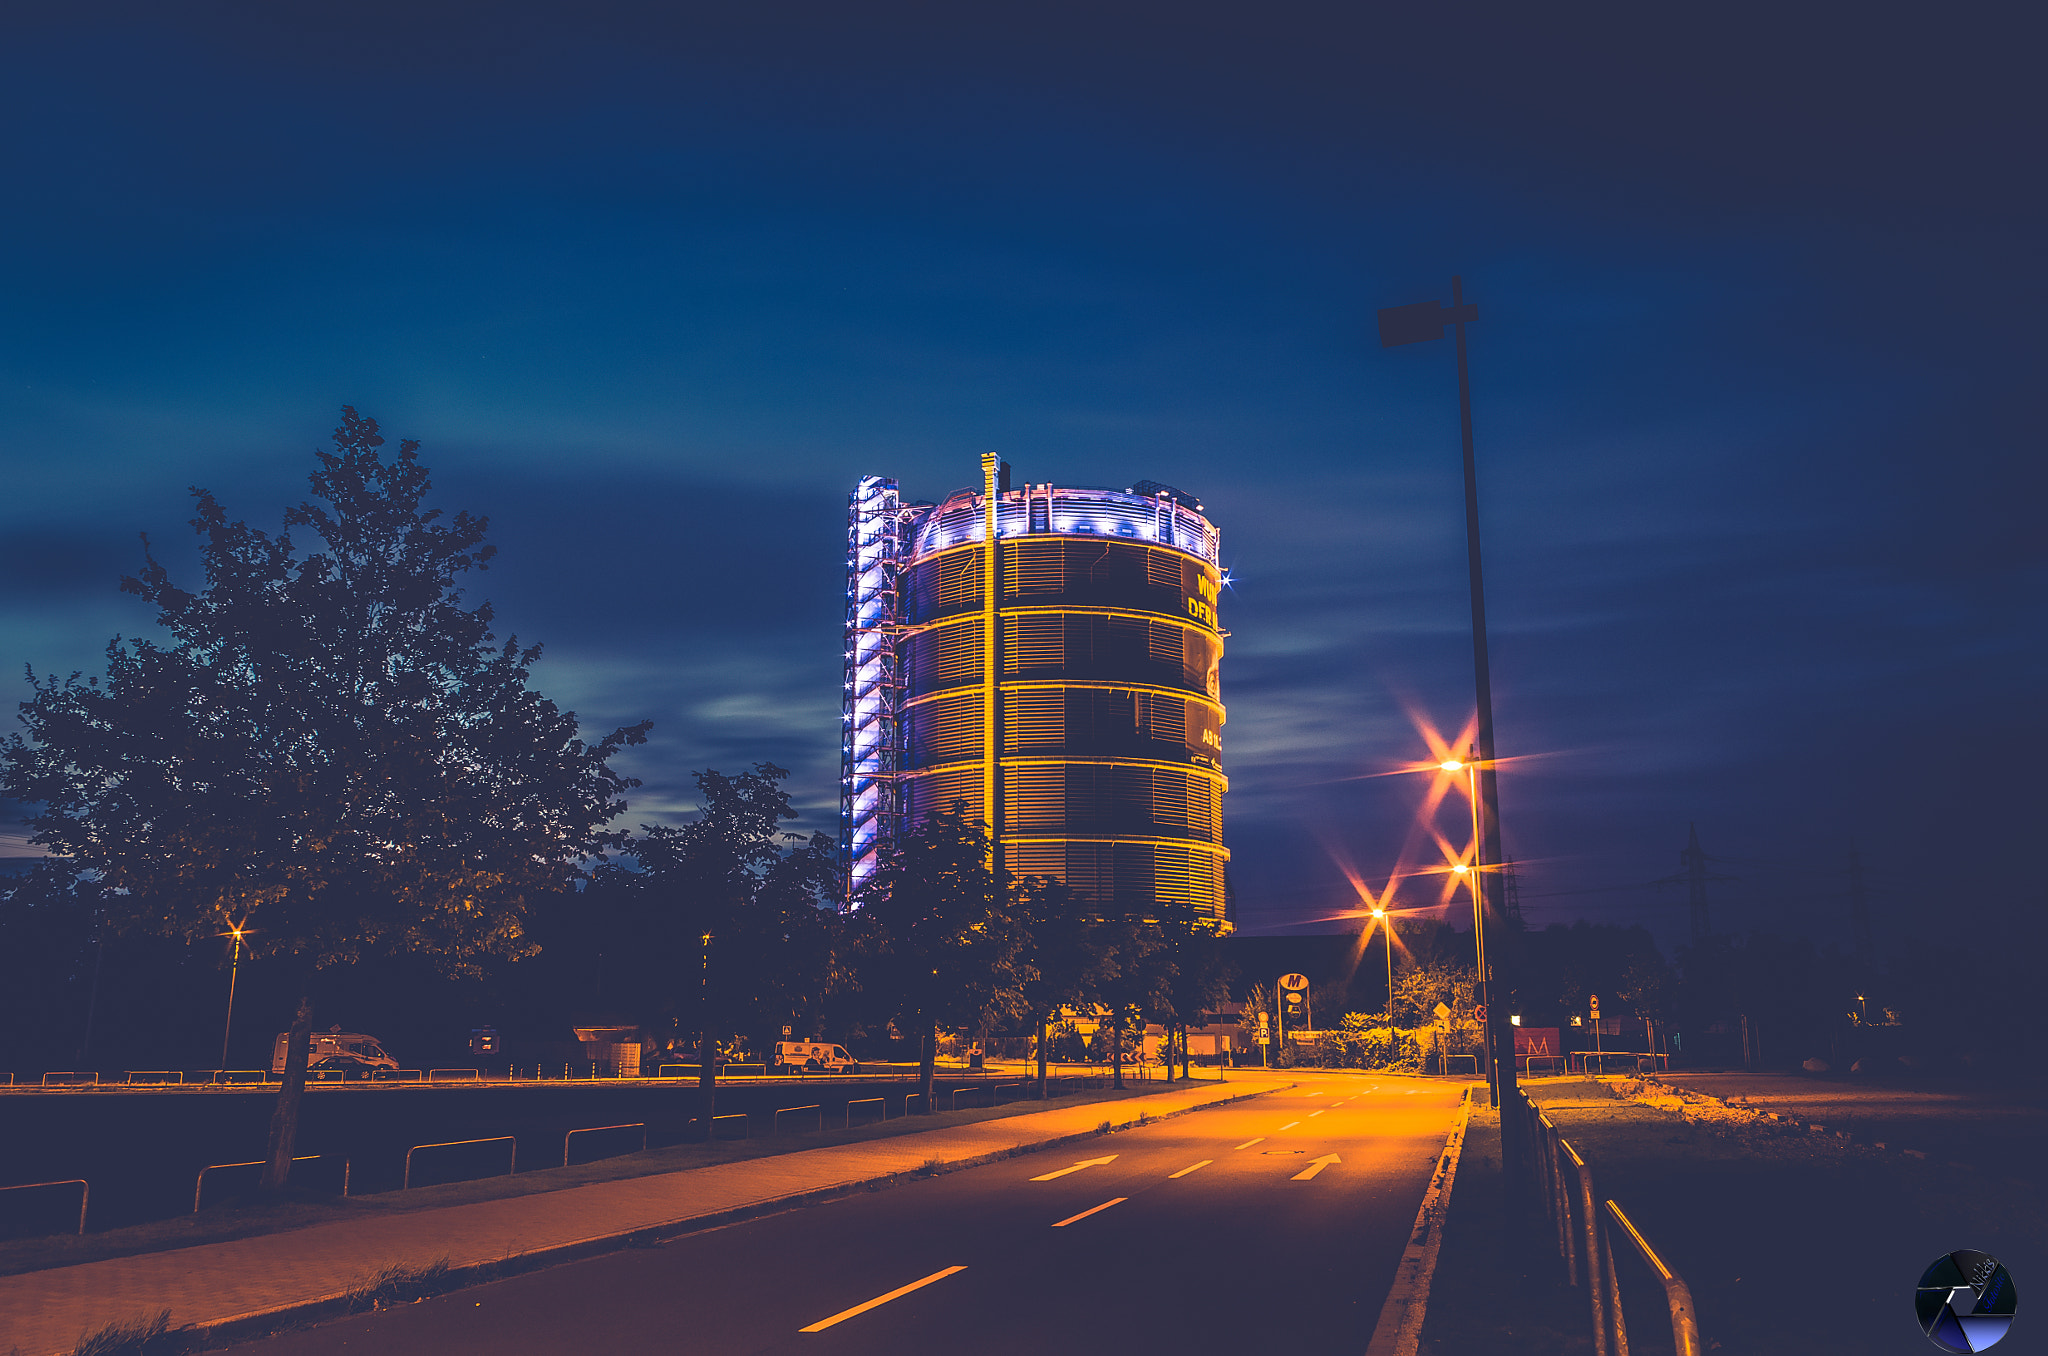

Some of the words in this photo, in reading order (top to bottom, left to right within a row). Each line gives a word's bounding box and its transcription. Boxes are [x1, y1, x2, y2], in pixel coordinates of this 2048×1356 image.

[1188, 596, 1212, 626] DER
[1202, 728, 1214, 746] AB
[1287, 975, 1302, 987] M
[1528, 1036, 1549, 1056] M
